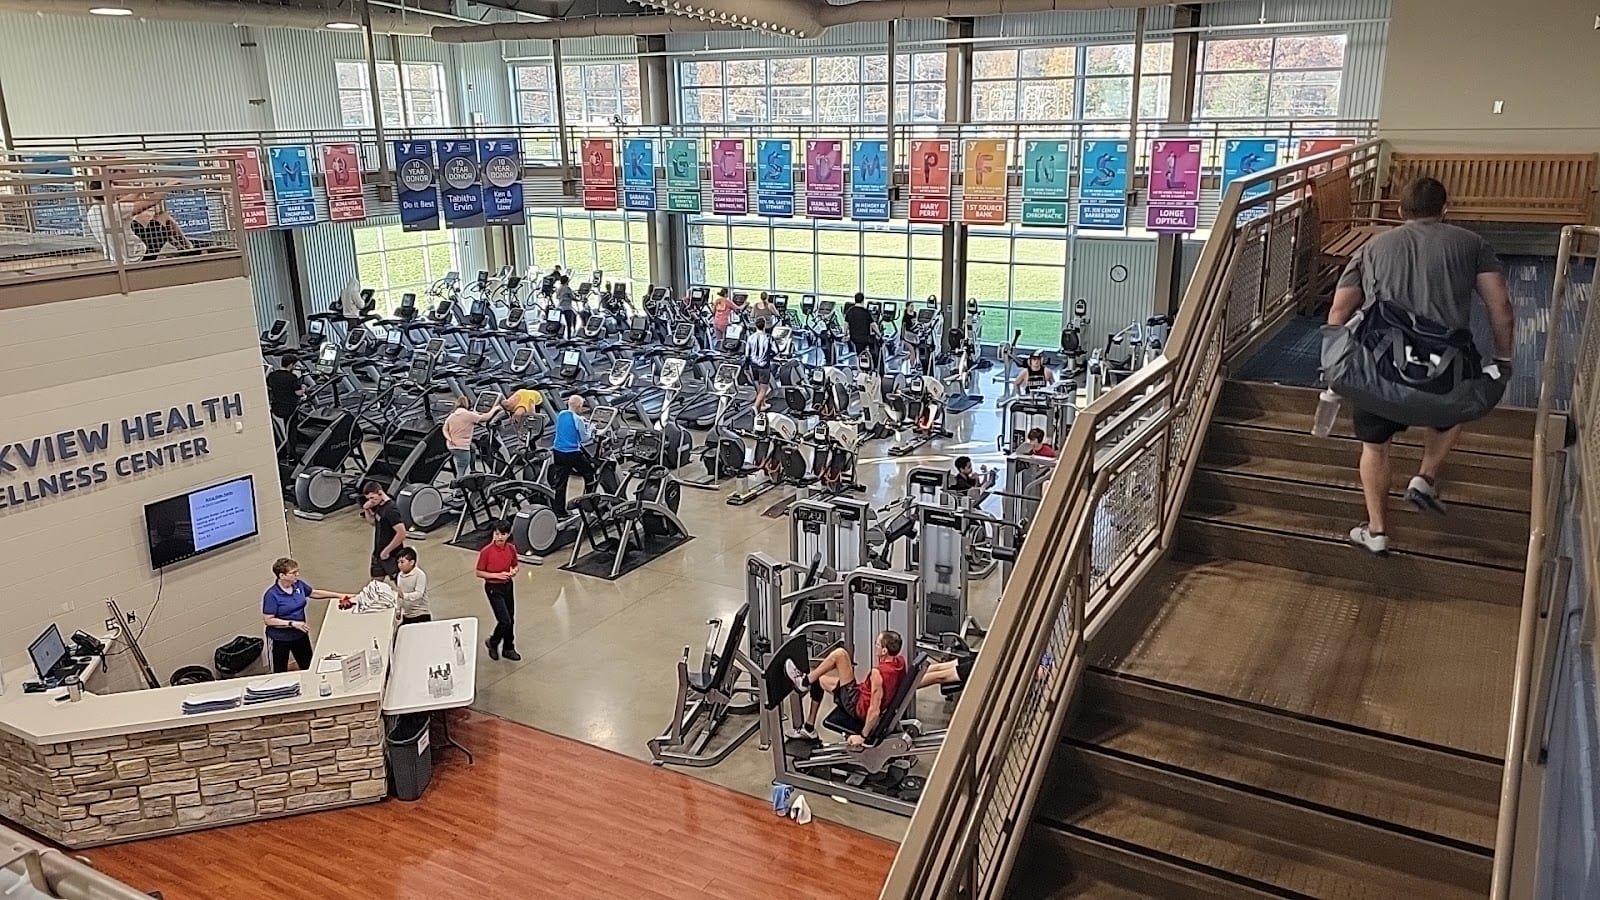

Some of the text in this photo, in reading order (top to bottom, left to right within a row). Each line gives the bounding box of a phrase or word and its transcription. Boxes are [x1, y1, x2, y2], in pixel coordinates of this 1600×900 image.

[448, 193, 477, 203] Tabitha
[495, 196, 513, 205] Kathy
[403, 201, 413, 209] Do
[420, 200, 435, 208] Best
[453, 202, 473, 211] Ervin
[978, 204, 1003, 212] SOURCE
[918, 209, 940, 217] PERRY
[1155, 217, 1188, 225] OPTICAL
[0, 393, 243, 472] KVIEW HEALTH
[115, 437, 210, 477] CENTER
